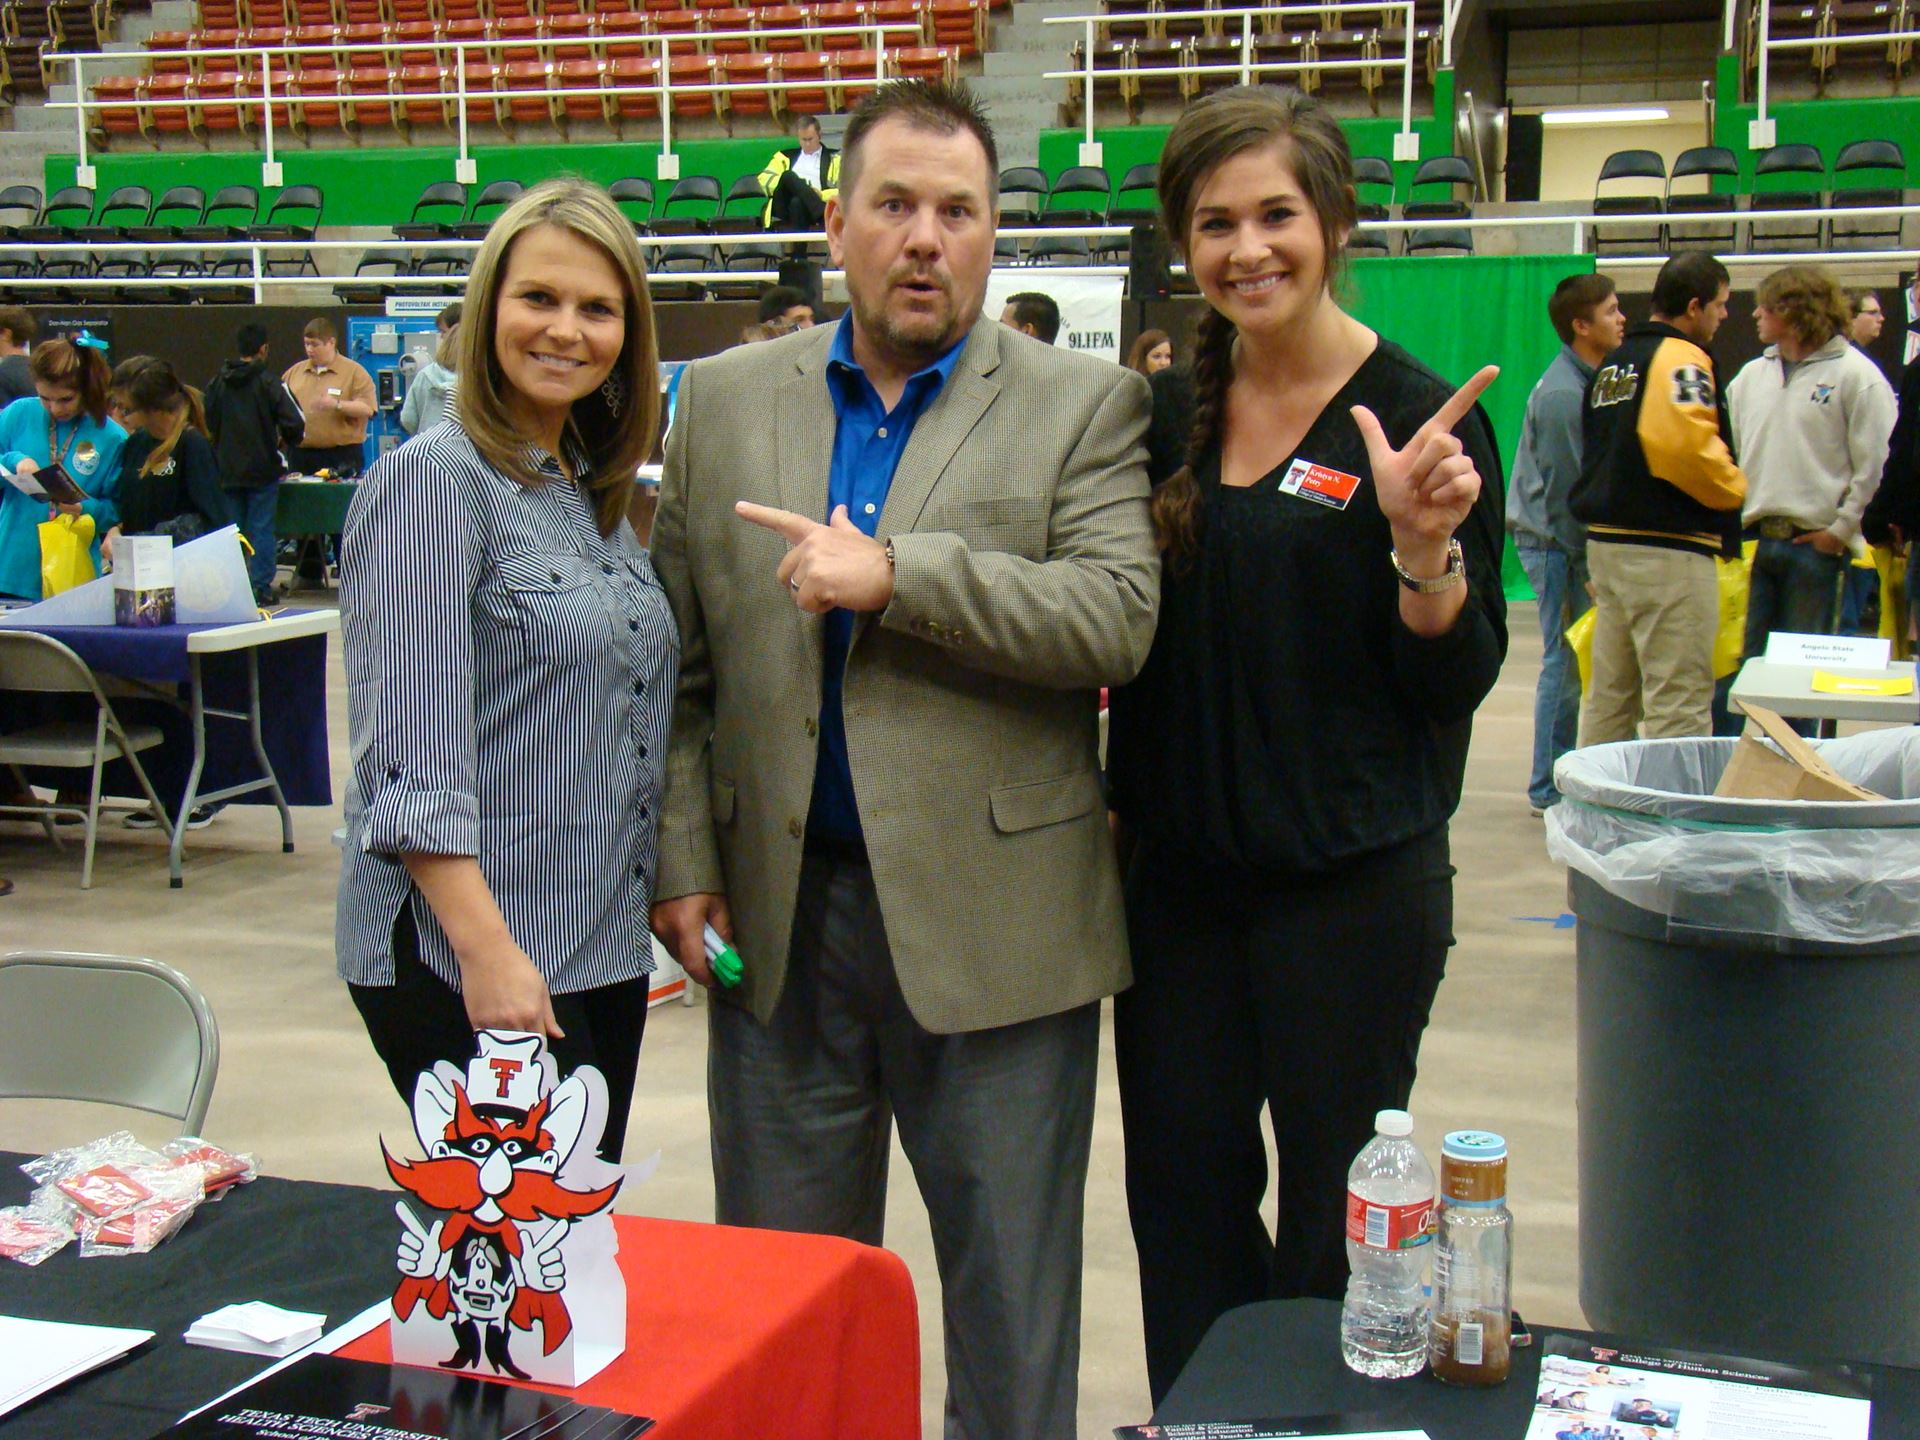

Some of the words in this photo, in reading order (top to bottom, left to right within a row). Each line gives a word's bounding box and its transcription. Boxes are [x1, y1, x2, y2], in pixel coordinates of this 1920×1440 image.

[1805, 653, 1847, 662] University
[1678, 1363, 1719, 1374] Human
[1722, 1369, 1769, 1381] Sciences
[239, 1408, 294, 1421] TEXAS
[295, 1415, 342, 1428] TECH
[217, 1414, 290, 1428] HEALTH
[287, 1423, 371, 1440] SCIENCES
[1208, 1423, 1254, 1431] Consumer
[255, 1429, 300, 1440] School
[1219, 1432, 1243, 1440] Teach
[1275, 1429, 1301, 1437] Grade
